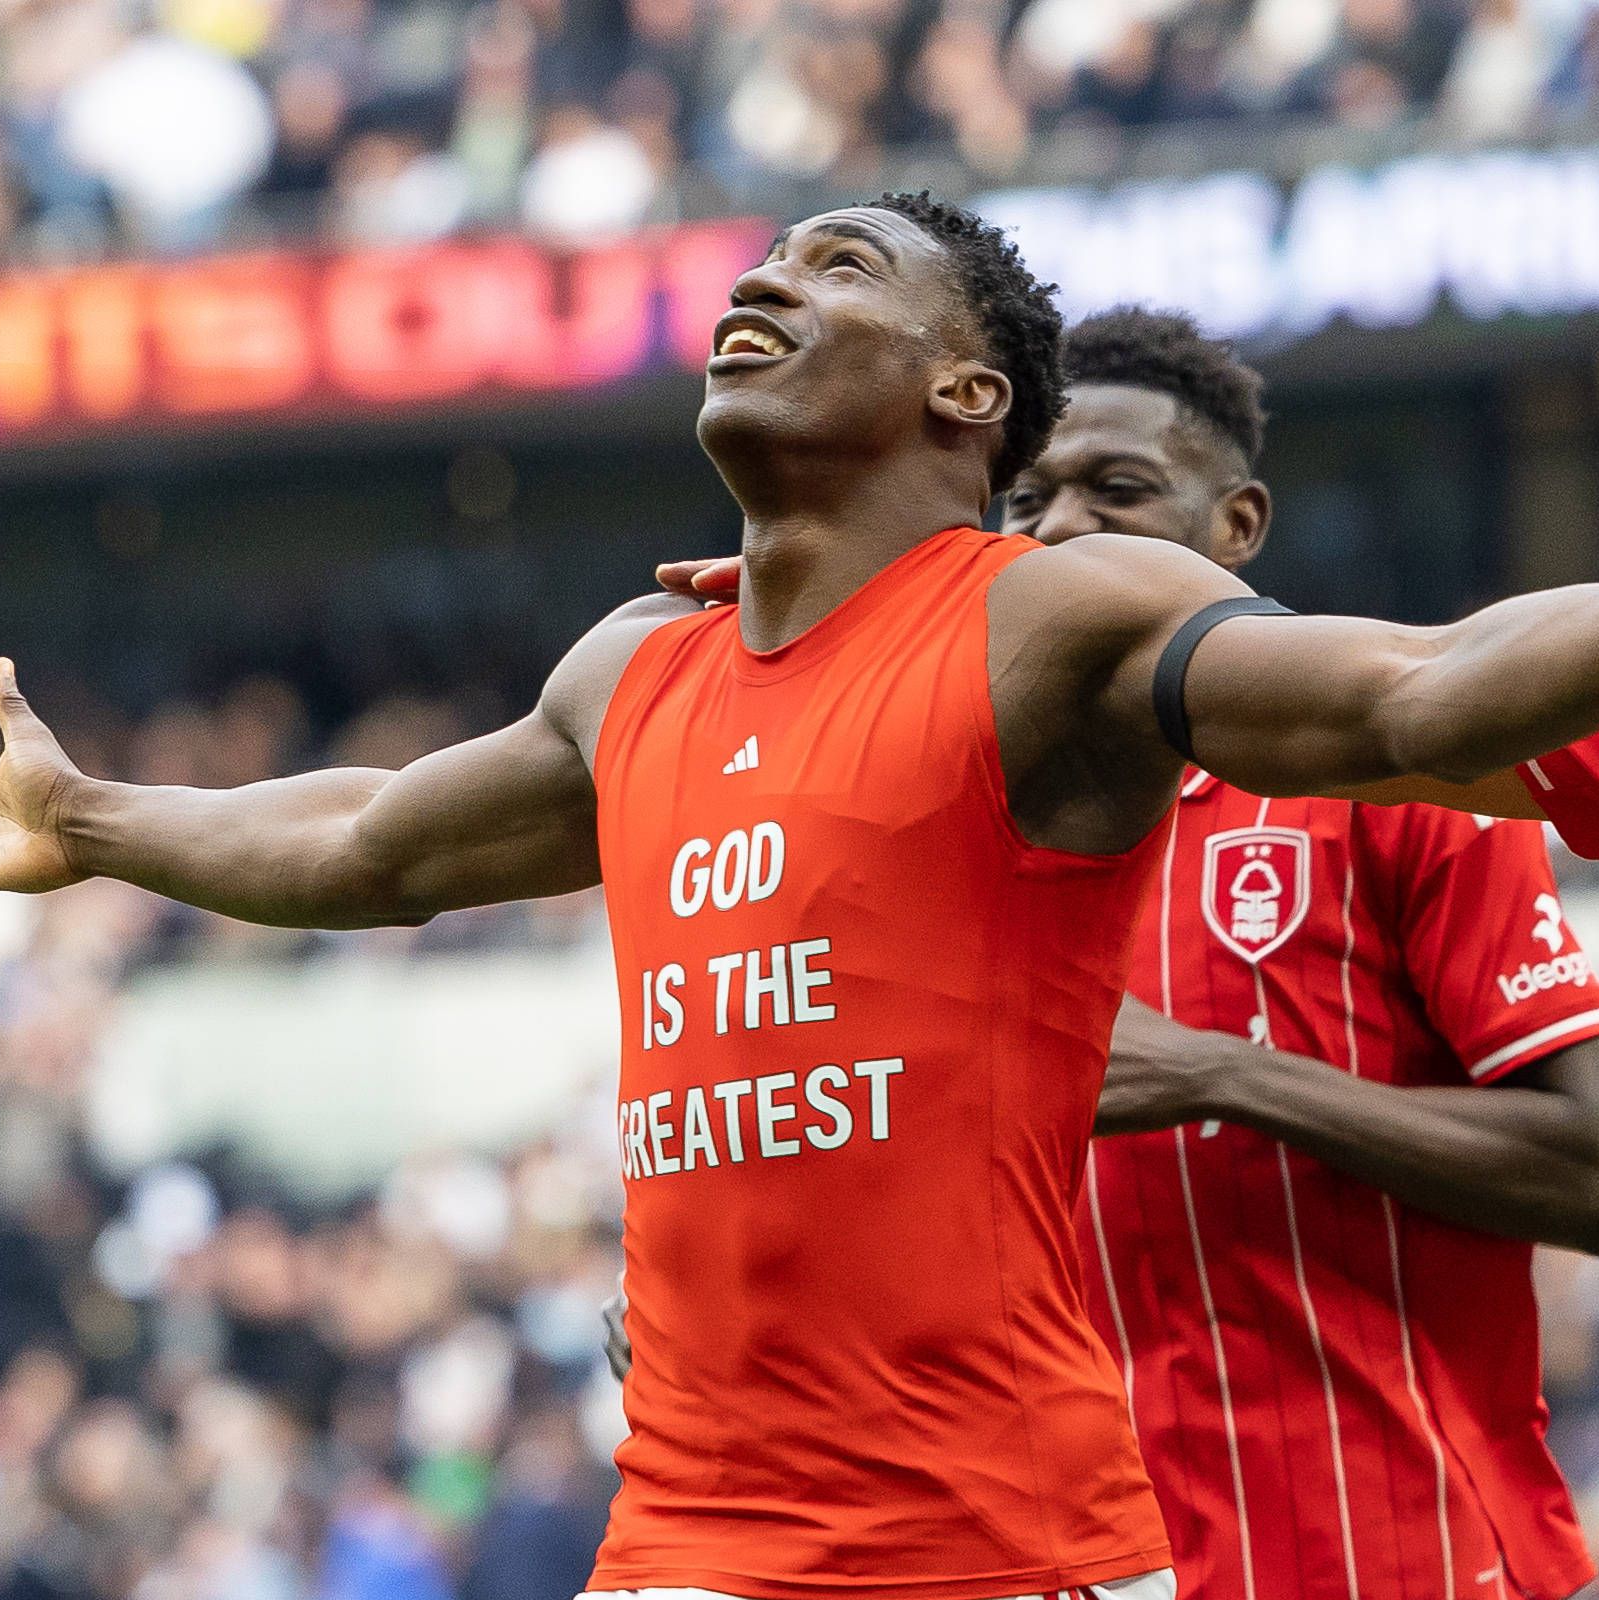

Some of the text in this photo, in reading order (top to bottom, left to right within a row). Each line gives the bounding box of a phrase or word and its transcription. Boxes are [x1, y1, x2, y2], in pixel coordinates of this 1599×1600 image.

[669, 820, 786, 919] GOD
[642, 936, 838, 1051] IS THE
